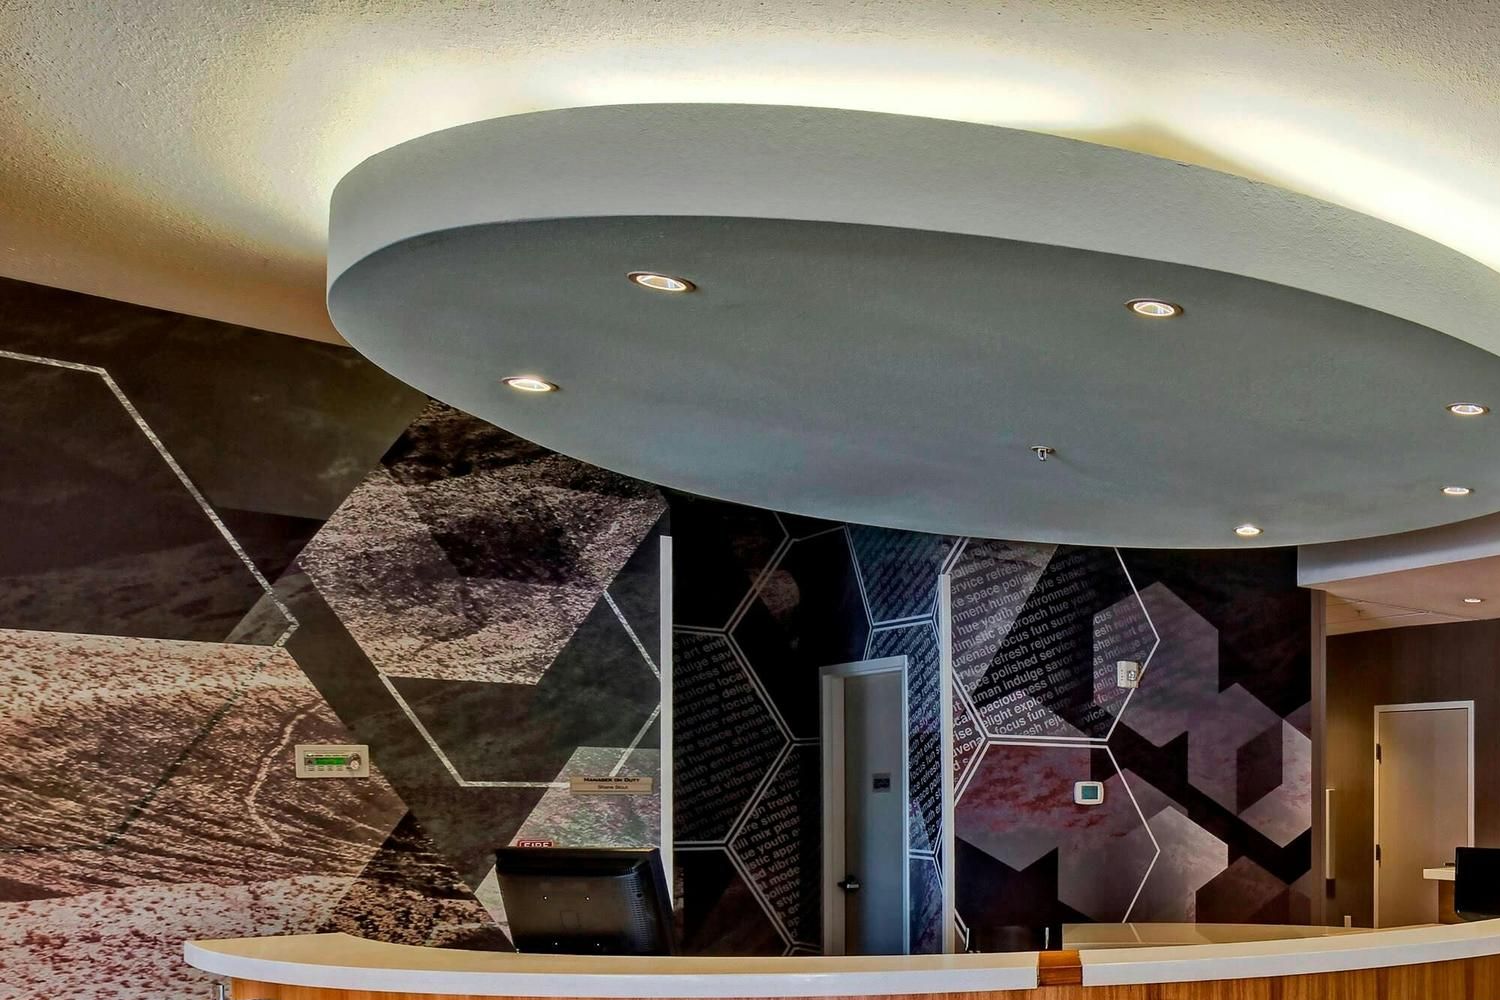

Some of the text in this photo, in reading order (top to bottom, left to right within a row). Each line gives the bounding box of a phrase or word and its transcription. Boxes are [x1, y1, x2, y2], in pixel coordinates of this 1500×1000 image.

[988, 588, 1028, 609] human
[981, 606, 1014, 630] youth
[991, 654, 1039, 683] polished
[1003, 667, 1045, 691] indulge
